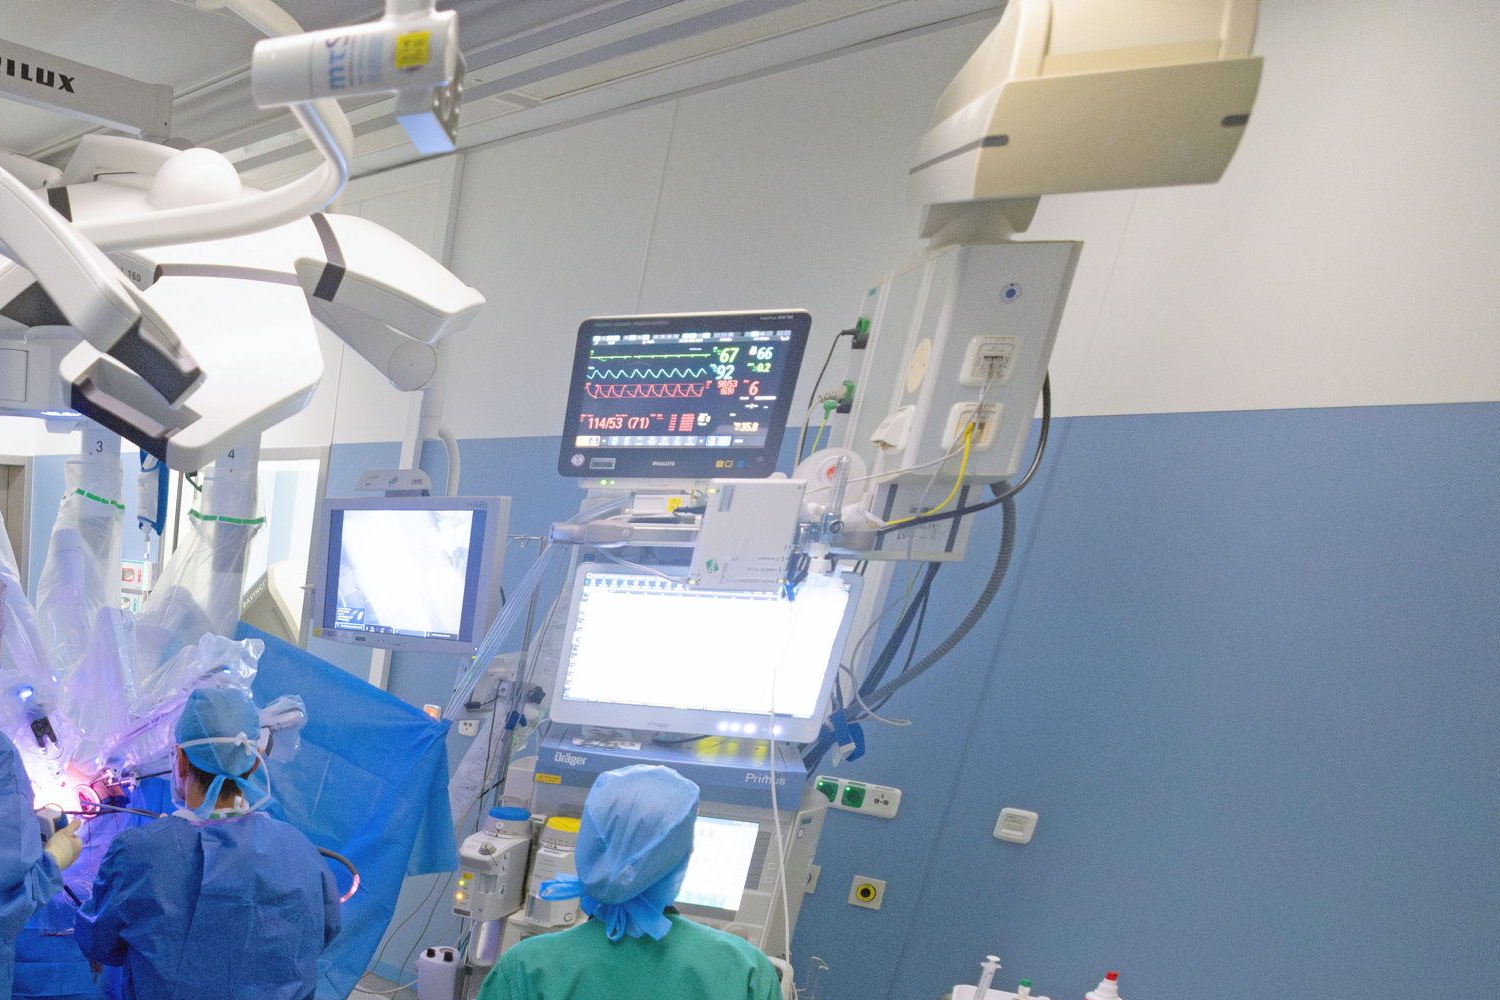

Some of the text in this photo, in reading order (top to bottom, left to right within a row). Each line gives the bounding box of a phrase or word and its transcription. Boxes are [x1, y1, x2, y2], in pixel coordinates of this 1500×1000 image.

[719, 347, 740, 363] 67
[756, 346, 774, 360] 66
[715, 364, 735, 380] 92
[748, 381, 760, 396] 6
[588, 416, 650, 429] 114/53 (71)
[95, 440, 103, 453] 3
[227, 449, 235, 460] 4
[554, 751, 588, 766] Dräger
